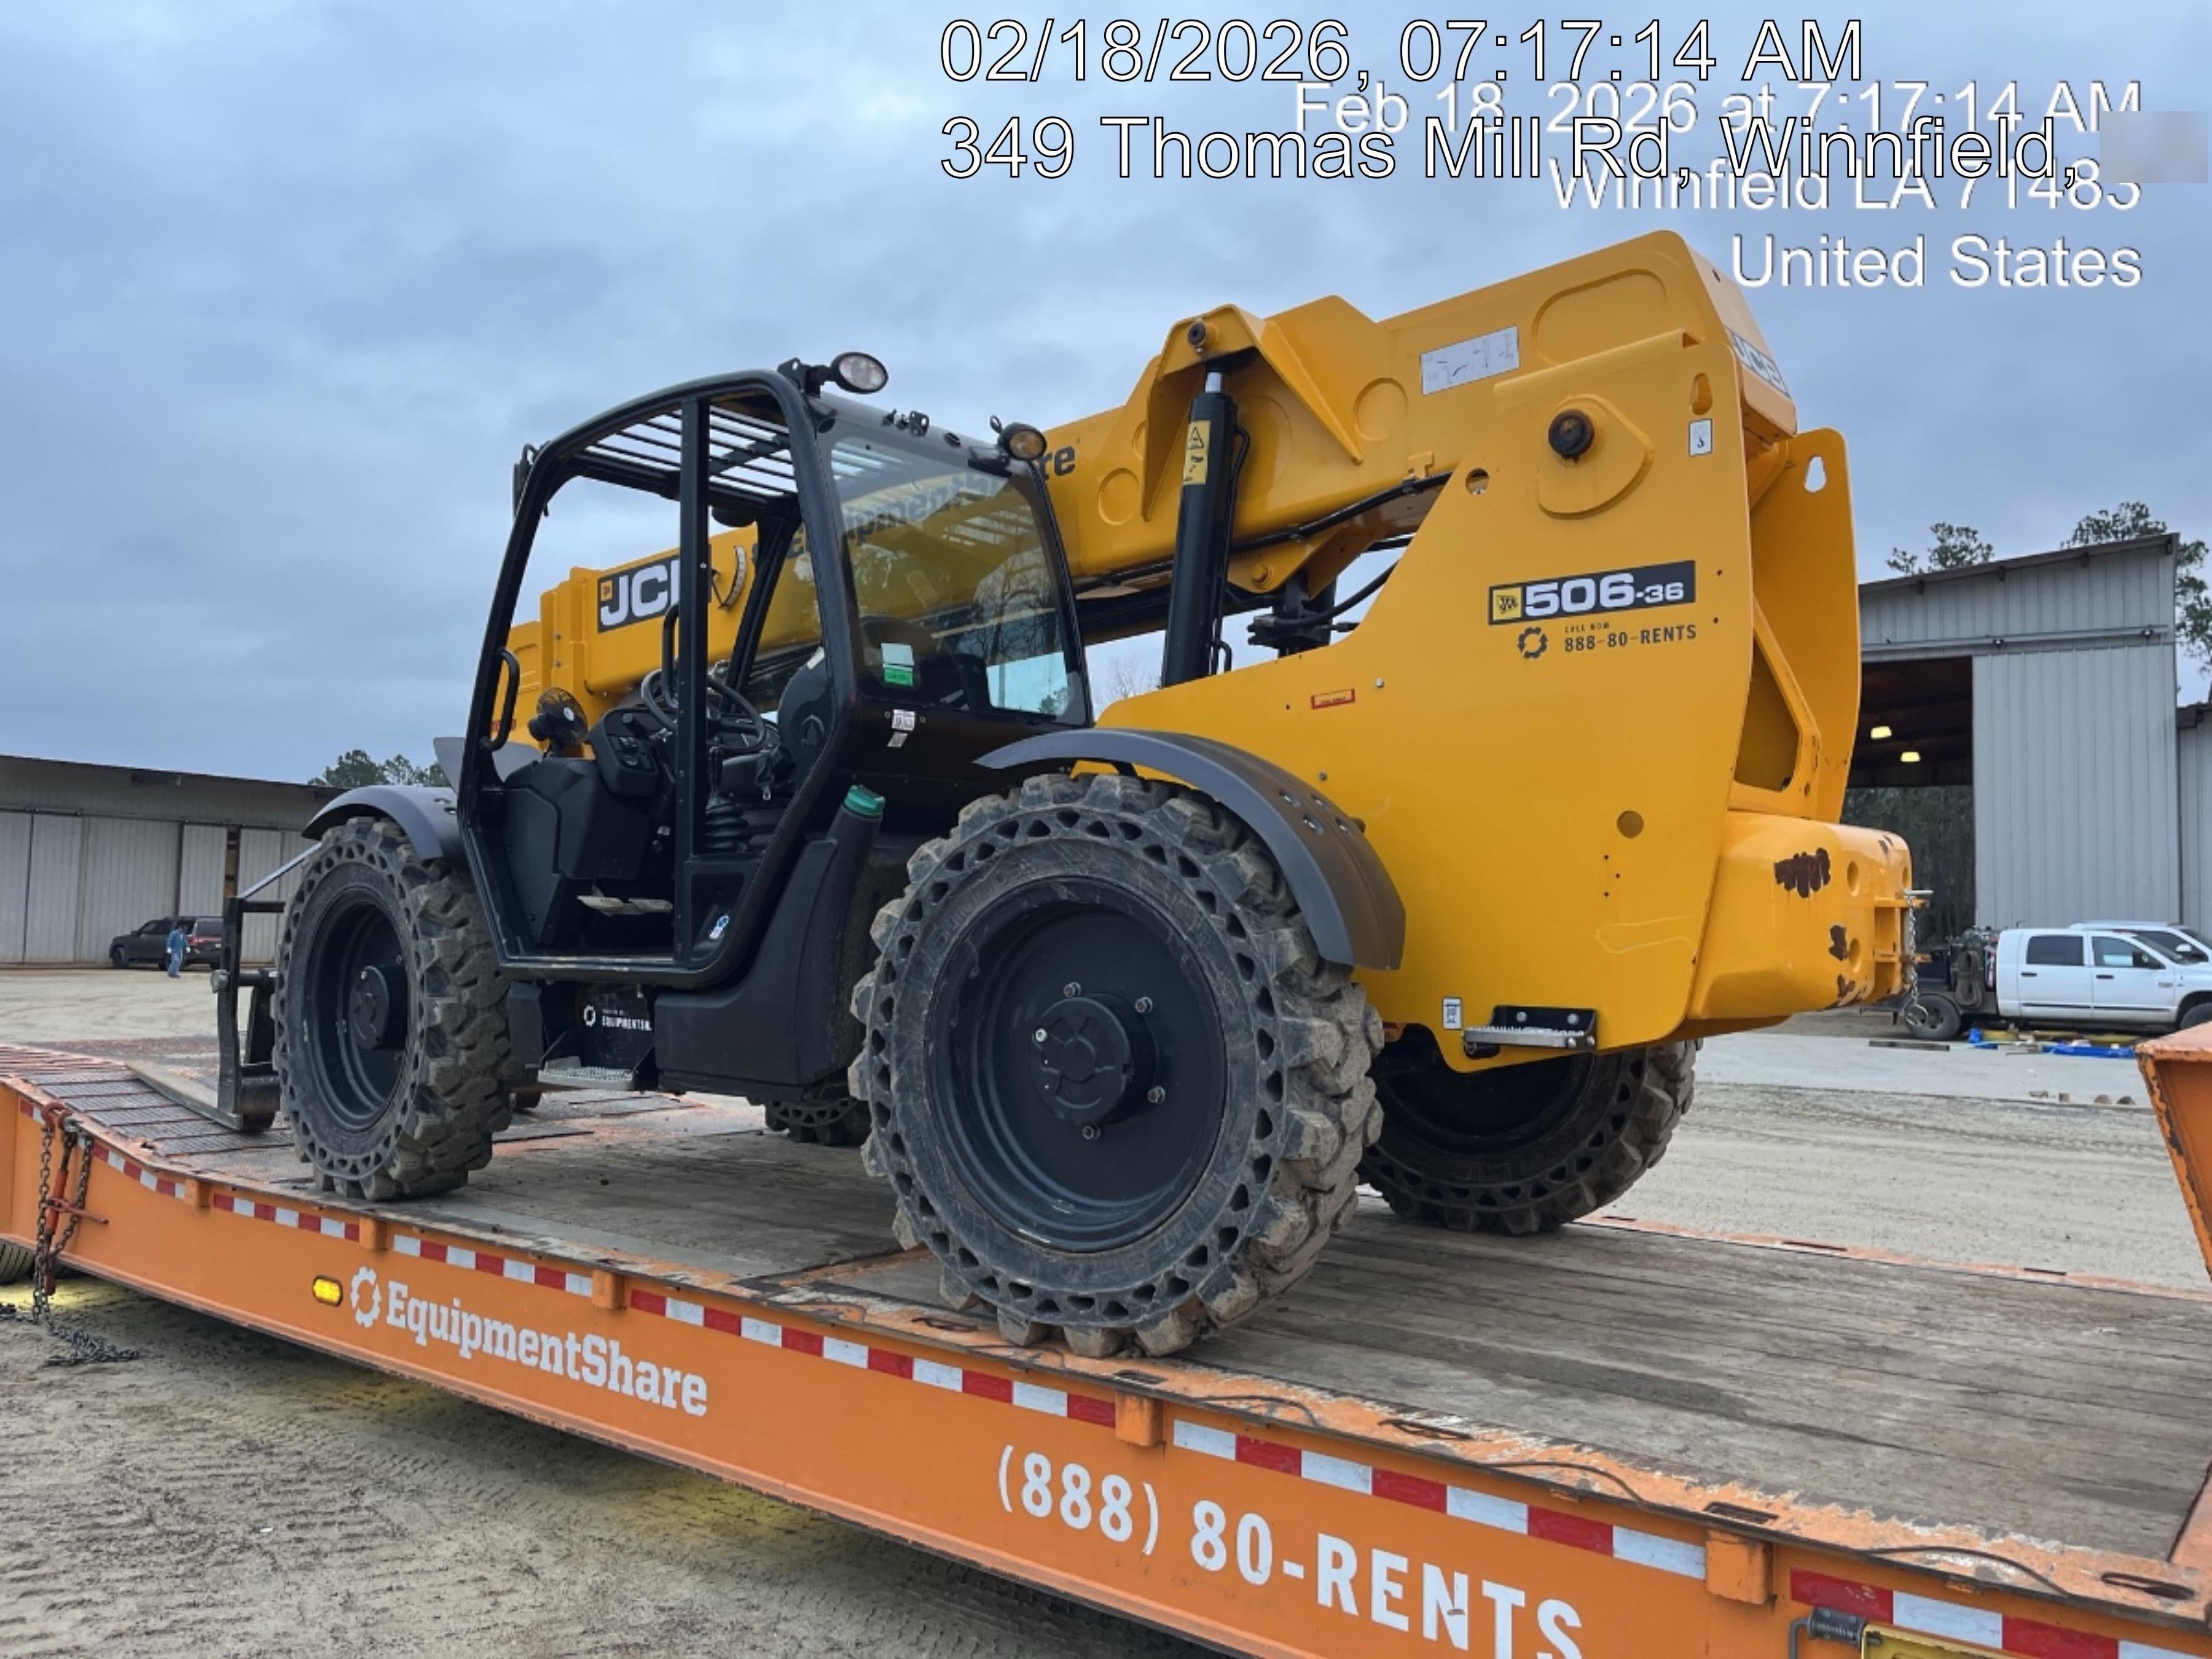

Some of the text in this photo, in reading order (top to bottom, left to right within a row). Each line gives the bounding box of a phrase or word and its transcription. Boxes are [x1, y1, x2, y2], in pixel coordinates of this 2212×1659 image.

[1564, 624, 1696, 652] 888-80-RENTS
[386, 1281, 707, 1416] EquipmentShare
[998, 1445, 1582, 1659] (888) 80-RENTS
